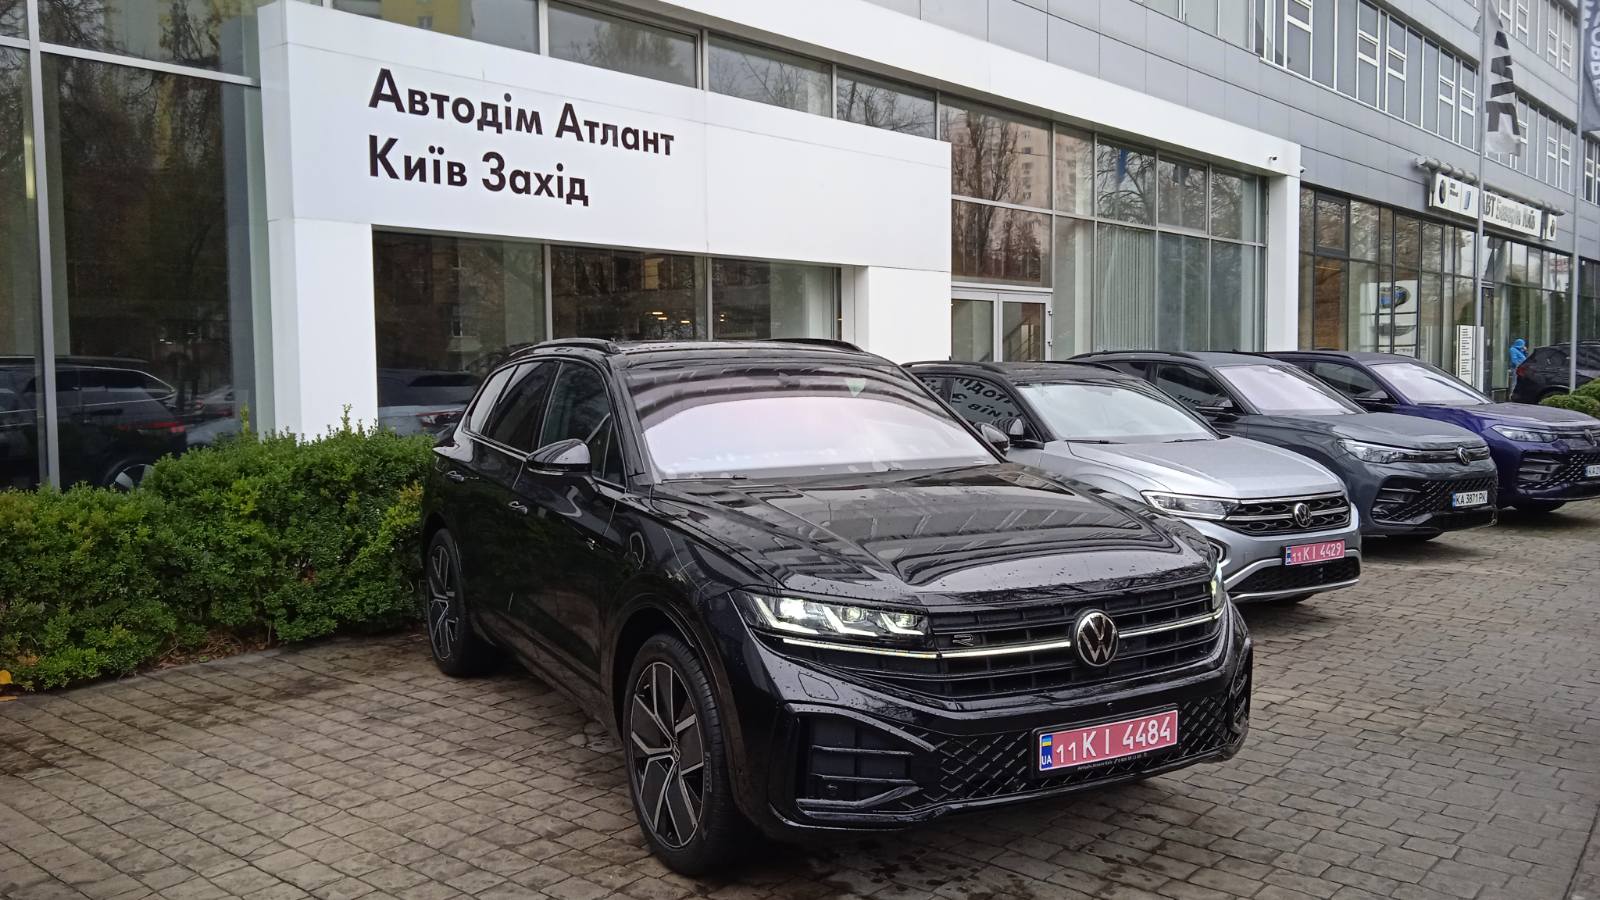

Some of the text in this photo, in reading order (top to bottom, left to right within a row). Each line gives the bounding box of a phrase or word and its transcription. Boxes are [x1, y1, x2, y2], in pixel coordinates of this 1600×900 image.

[368, 68, 675, 156] Автодім Атлант
[368, 134, 590, 207] Київ Захід
[1041, 755, 1052, 765] UA
[1122, 716, 1171, 749] 4484
